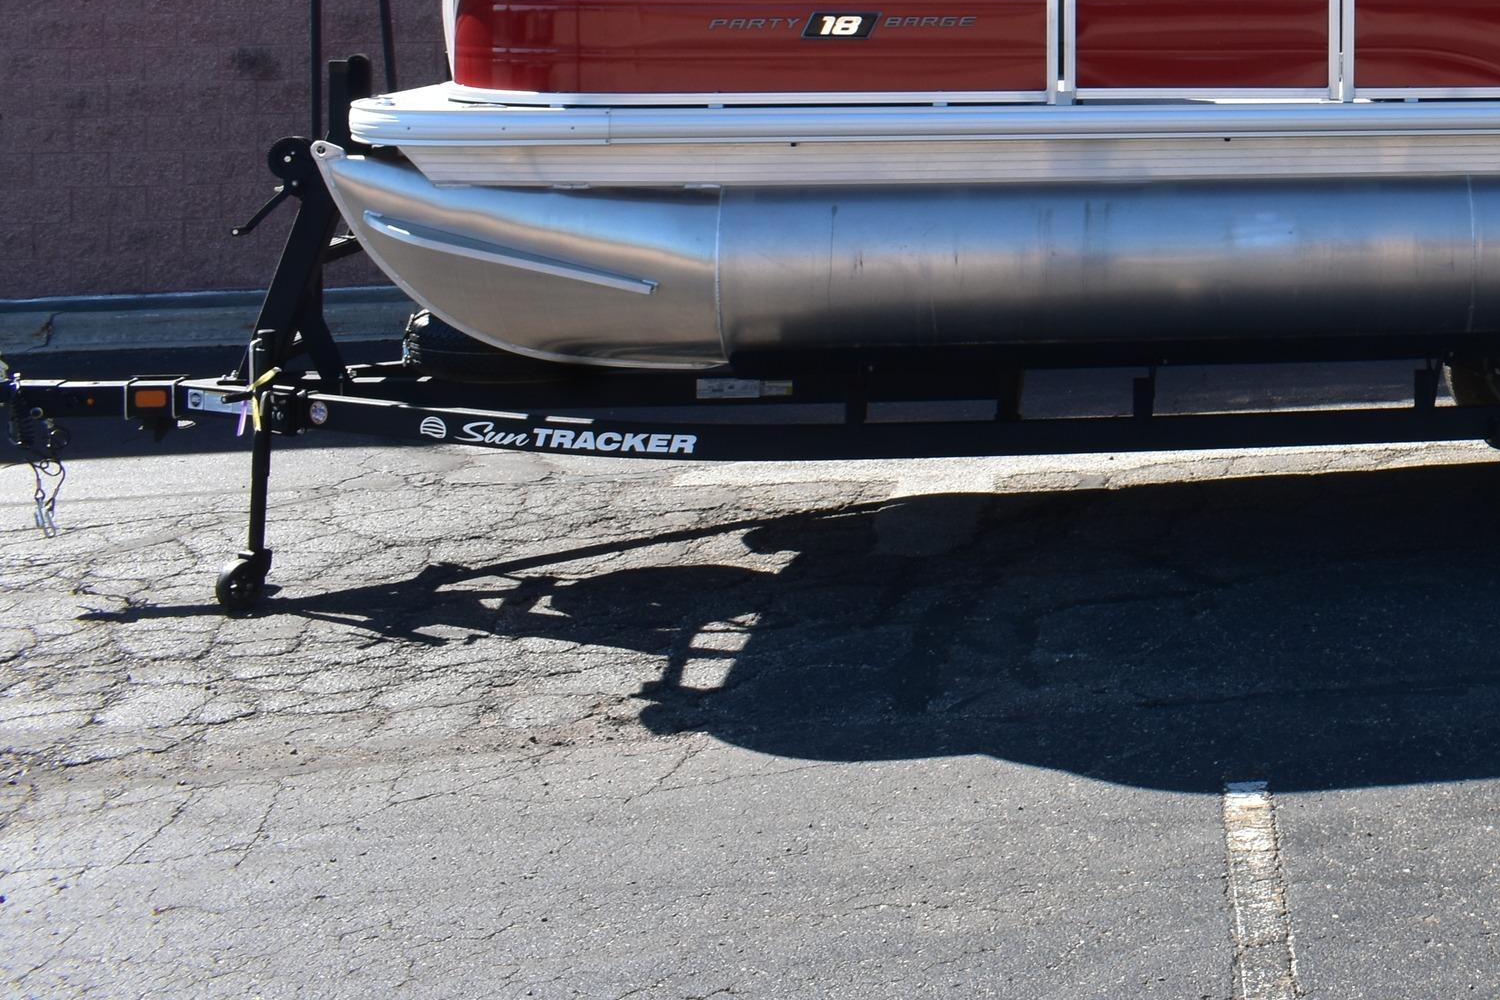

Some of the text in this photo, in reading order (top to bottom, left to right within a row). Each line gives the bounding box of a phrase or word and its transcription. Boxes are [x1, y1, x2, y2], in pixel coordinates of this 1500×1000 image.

[708, 15, 977, 36] PARTY 18 BARGE
[455, 421, 697, 454] Sun TRACKER
